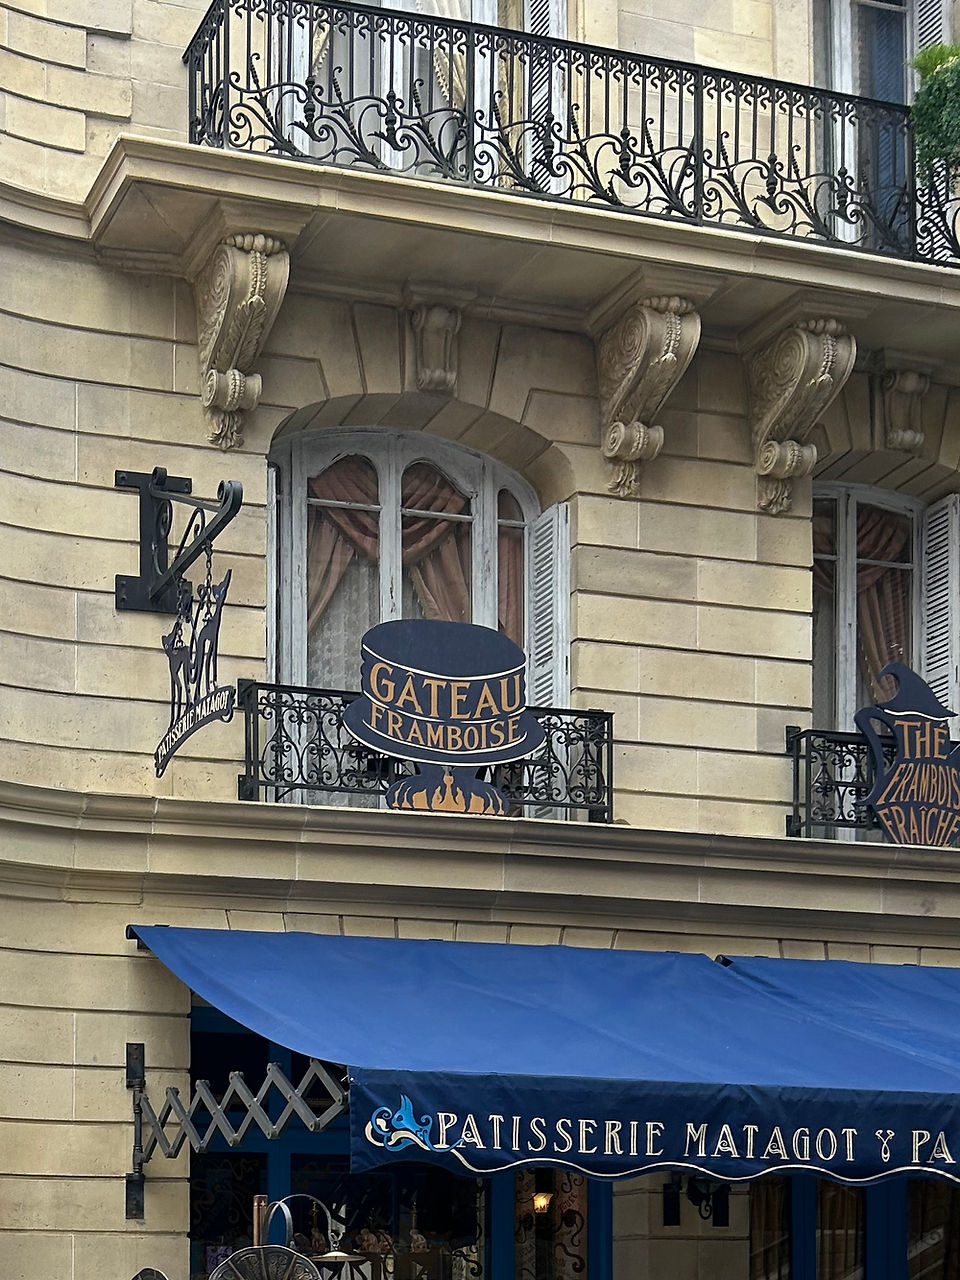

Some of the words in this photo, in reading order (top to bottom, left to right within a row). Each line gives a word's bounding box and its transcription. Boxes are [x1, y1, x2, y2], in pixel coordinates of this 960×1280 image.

[369, 661, 522, 720] GÂTEAU
[157, 709, 195, 764] PATISSERIE
[195, 690, 230, 723] MATAGOT
[369, 702, 522, 751] FRAMBOISE
[894, 720, 948, 760] THÉ
[436, 1111, 666, 1157] PATISSERIE
[682, 1122, 859, 1162] MATAGOT
